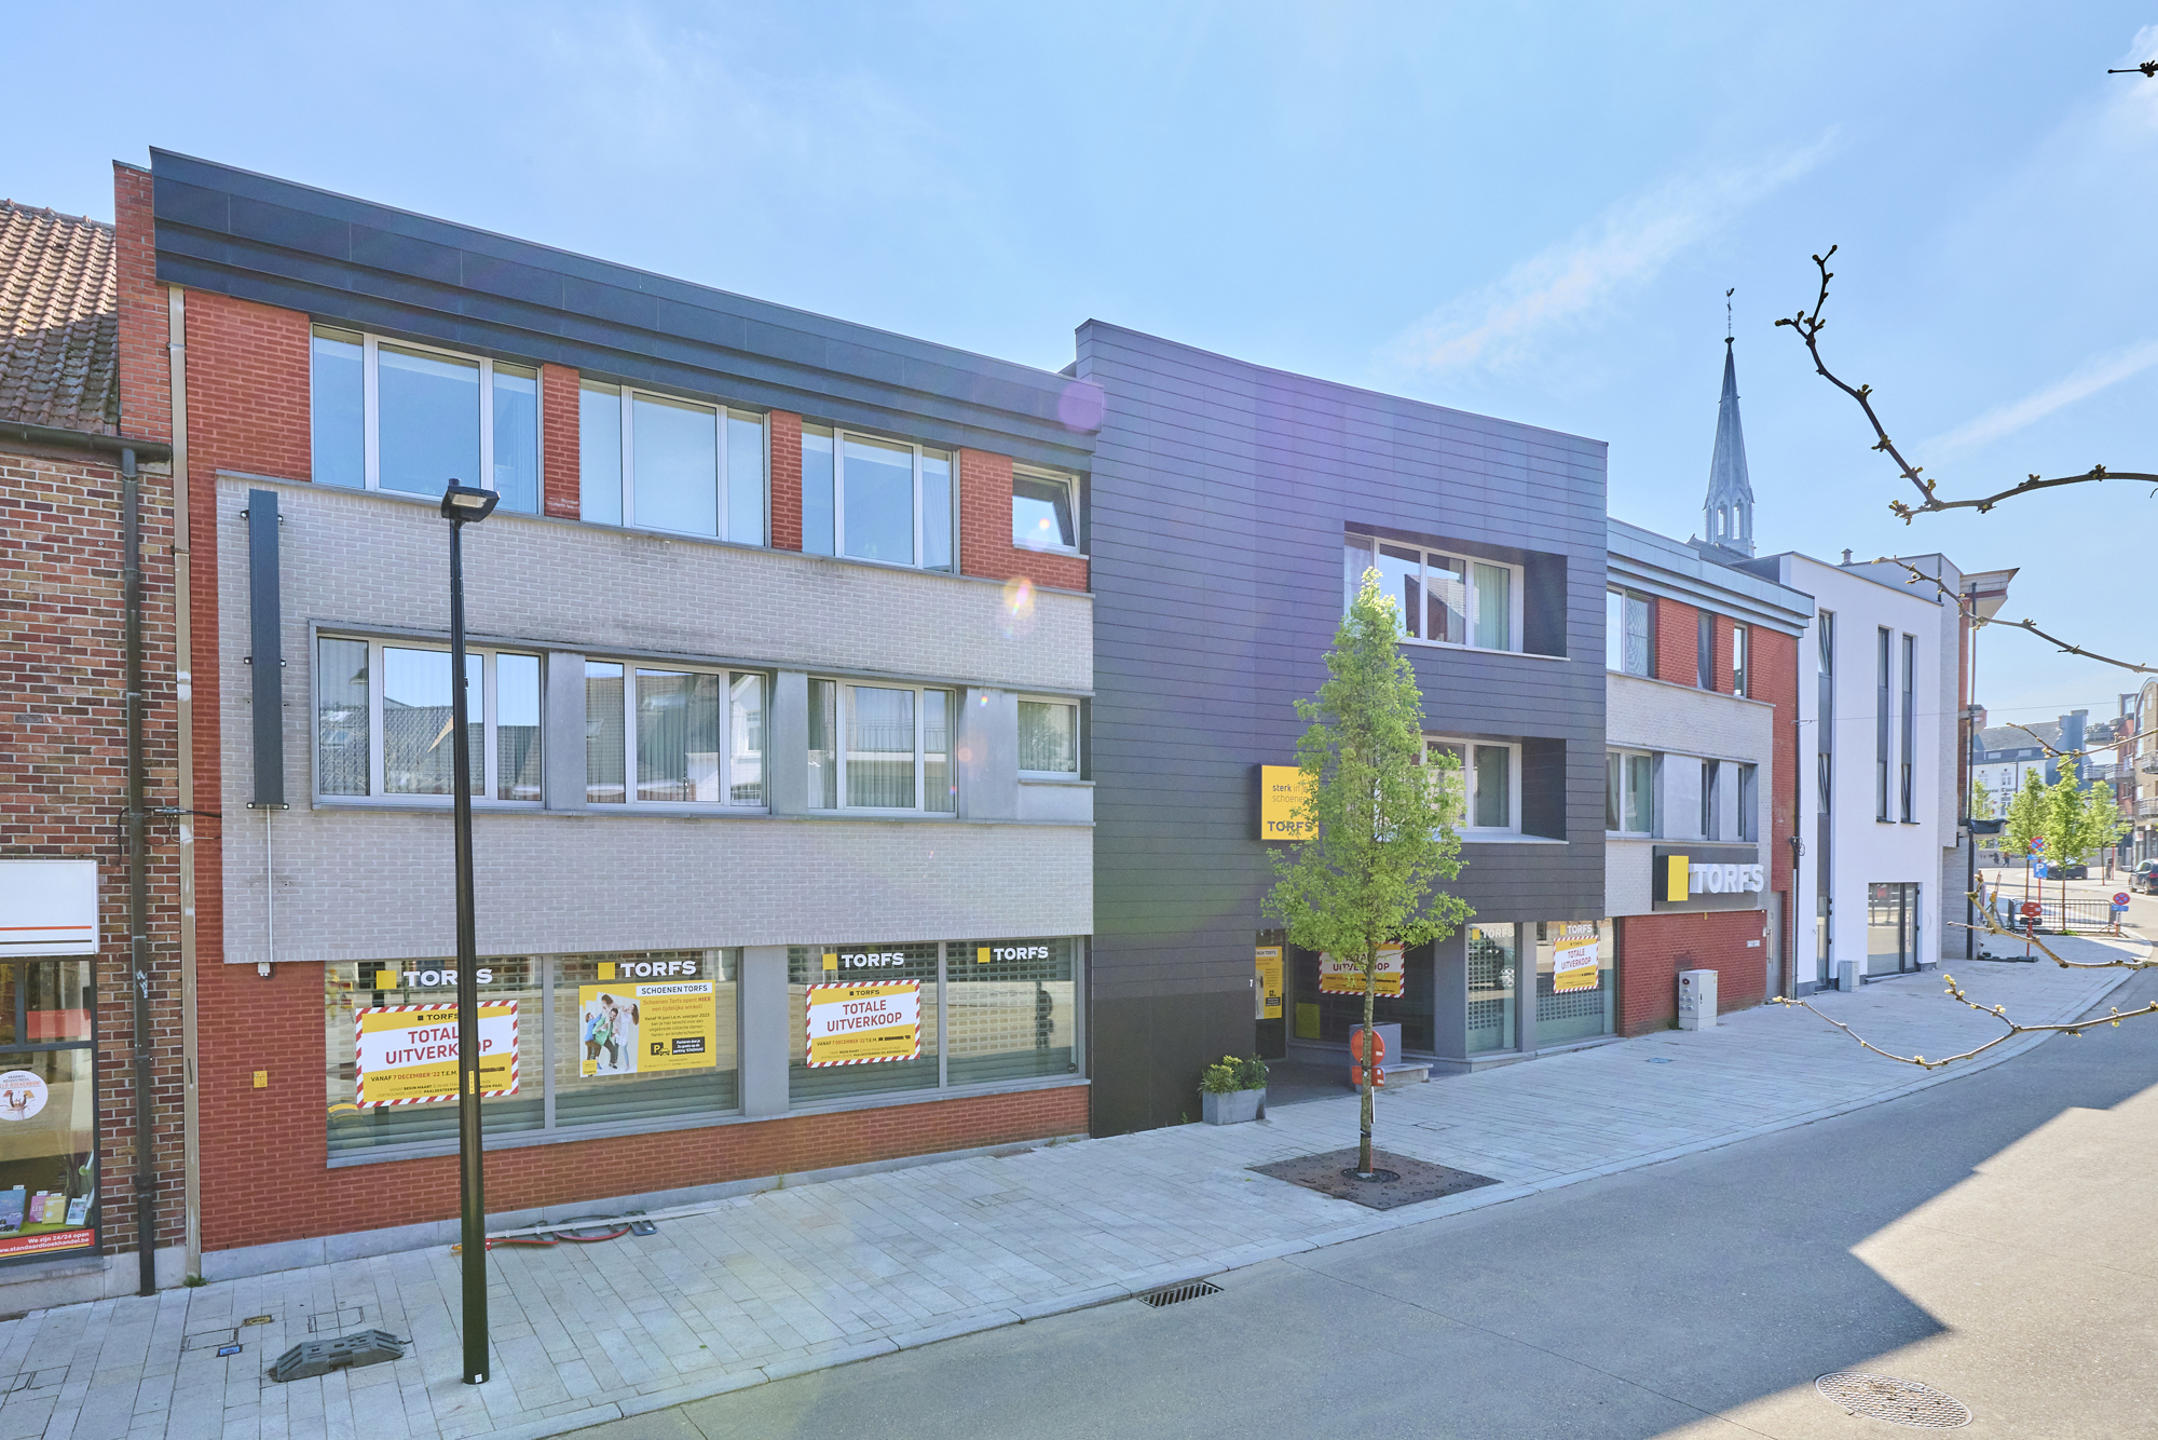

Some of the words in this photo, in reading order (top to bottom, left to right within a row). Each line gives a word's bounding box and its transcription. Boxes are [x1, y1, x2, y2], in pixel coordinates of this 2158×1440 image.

[1272, 784, 1291, 792] sterk
[1267, 820, 1313, 832] TORFS
[1690, 864, 1764, 893] TORFS
[1567, 924, 1592, 935] TORFS
[841, 953, 904, 967] TORFS
[993, 946, 1049, 961] TORFS
[1567, 948, 1585, 958] TOTALE
[620, 960, 697, 977] TORFS
[1561, 956, 1592, 970] UITVERKOOP
[403, 968, 493, 987] TORS
[641, 986, 683, 995] SCHOENEN
[842, 1000, 887, 1016] TOTALE
[826, 1012, 902, 1033] UITVERKOOP
[408, 1026, 459, 1044] TOTAL
[385, 1039, 493, 1064] UITVERKP
[73, 1232, 89, 1240] open
